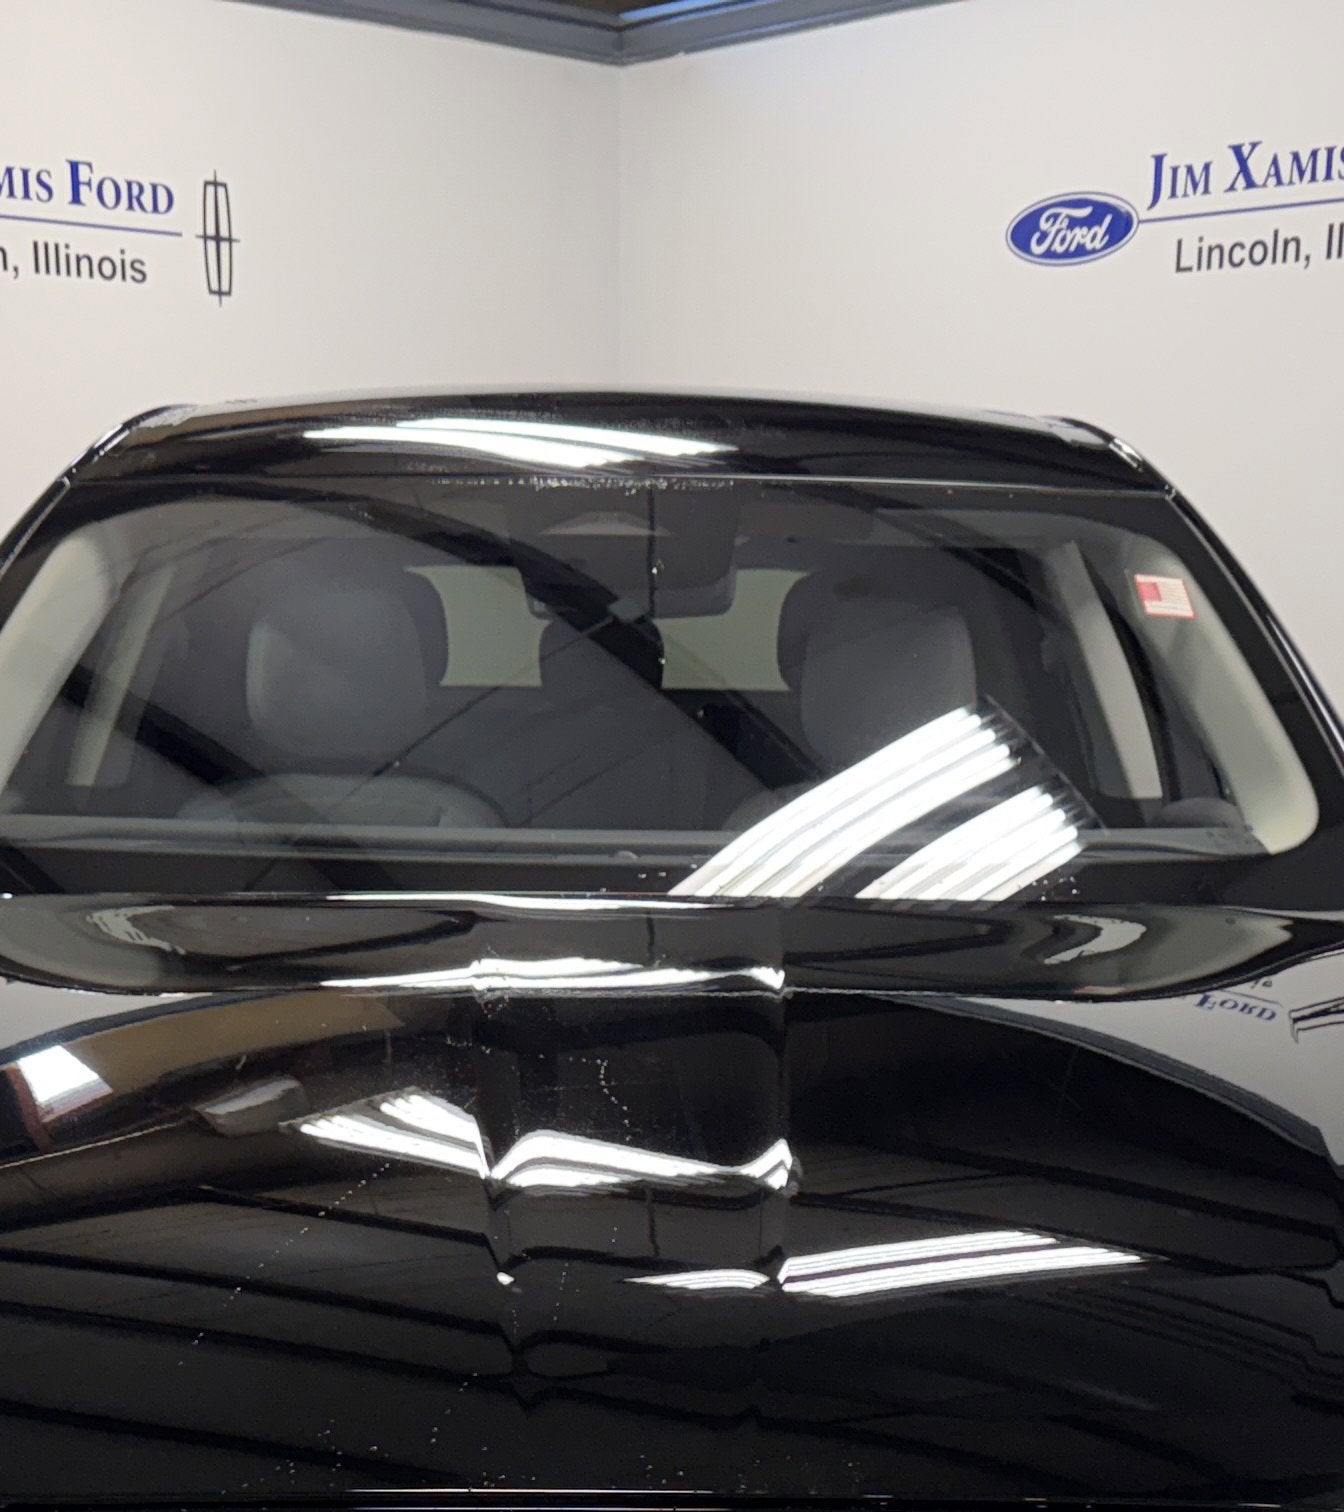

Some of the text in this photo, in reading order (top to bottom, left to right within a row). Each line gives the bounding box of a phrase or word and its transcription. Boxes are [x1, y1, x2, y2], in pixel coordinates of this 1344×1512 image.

[66, 160, 174, 214] FORD
[1147, 153, 1213, 211] JIM
[1030, 204, 1112, 254] Ford
[1176, 229, 1310, 273] Lincoln,
[32, 240, 148, 284] Illinois
